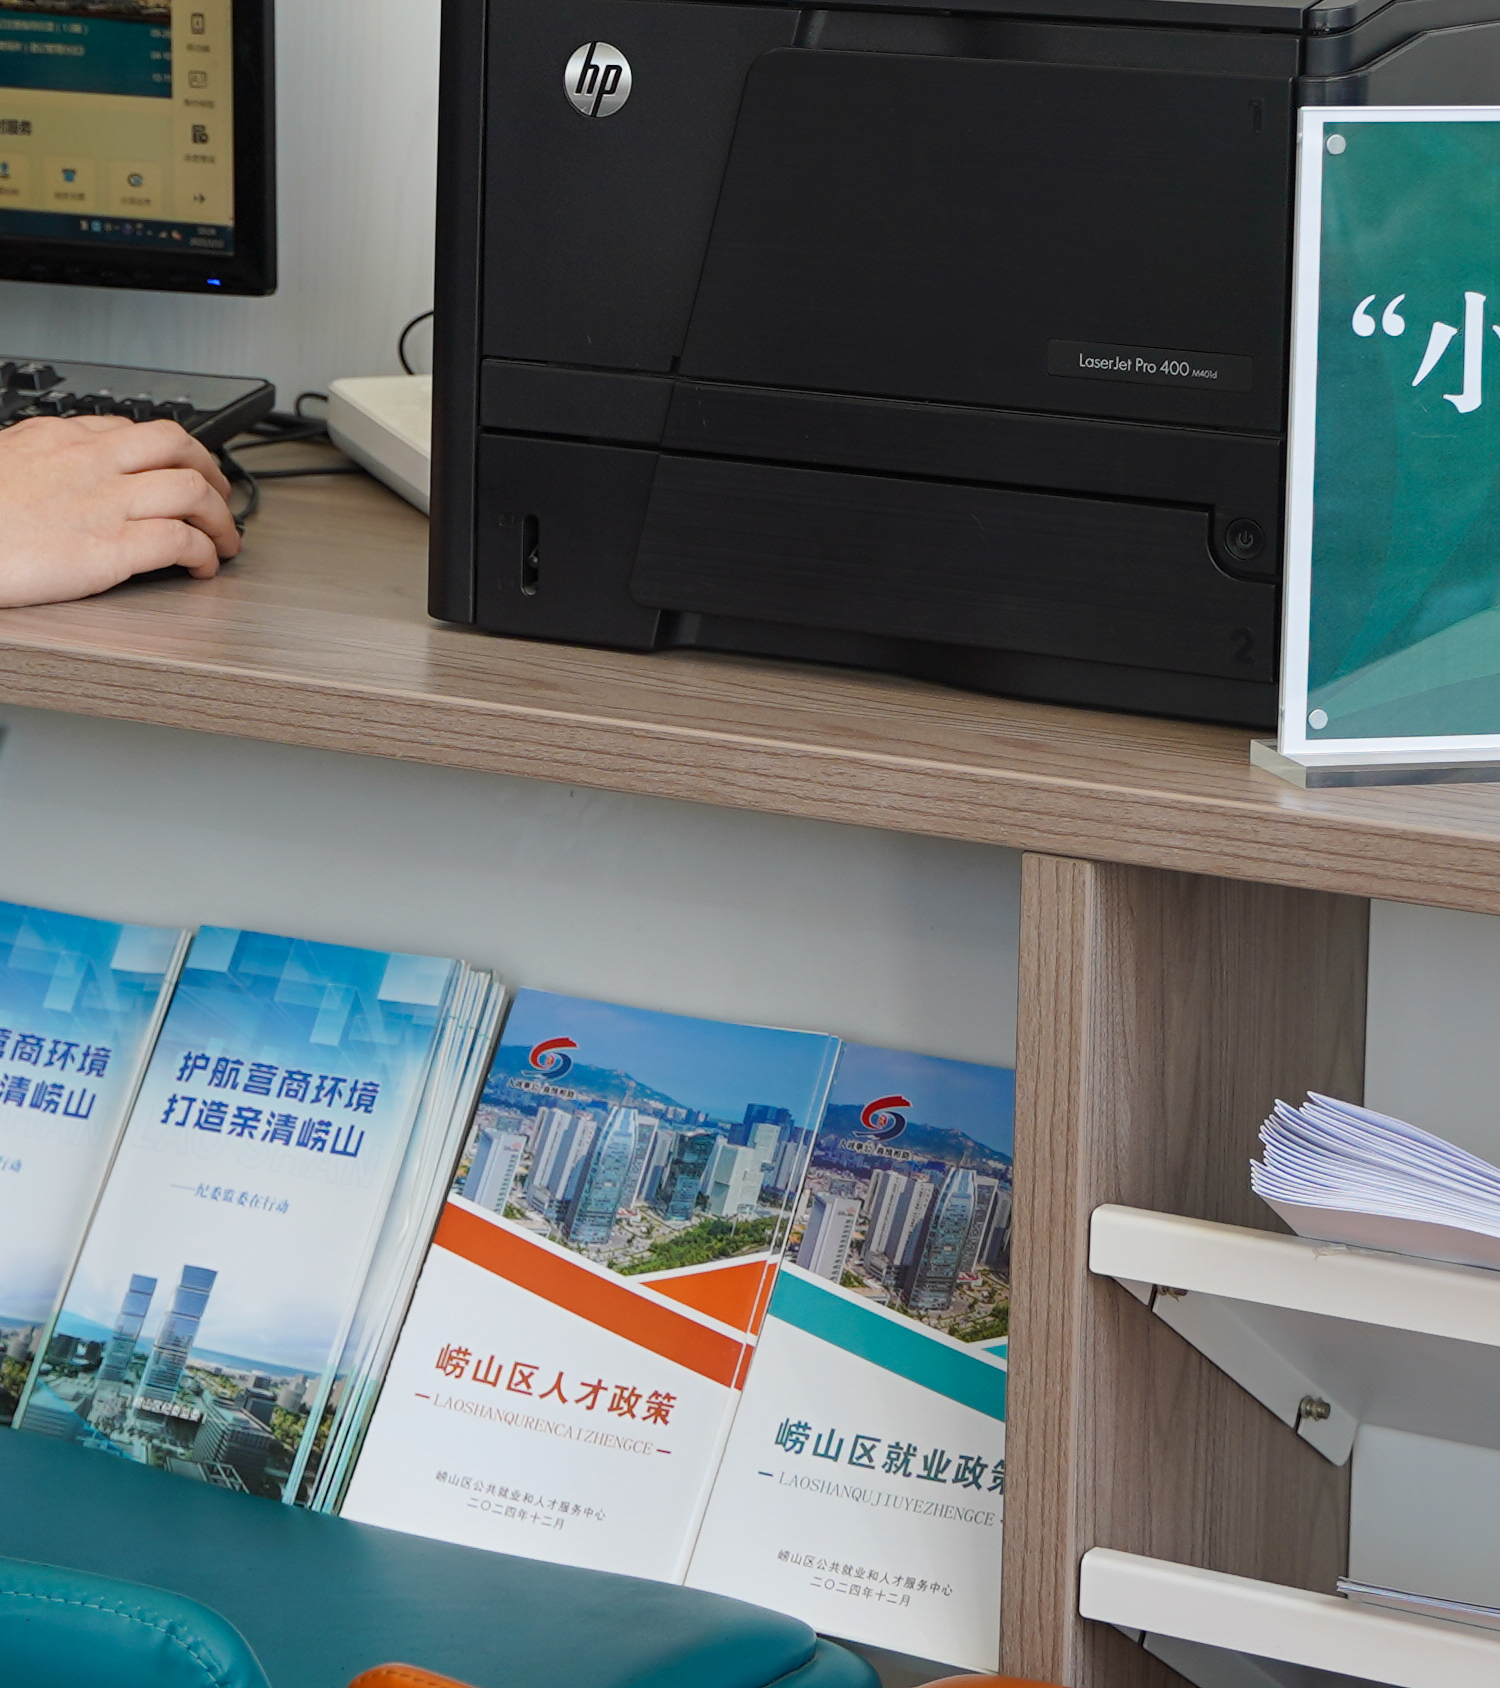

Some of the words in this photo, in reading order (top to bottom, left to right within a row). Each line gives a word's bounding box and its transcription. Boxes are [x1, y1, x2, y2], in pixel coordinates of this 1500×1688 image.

[574, 41, 623, 118] hp
[1079, 352, 1132, 373] LaserJet
[1135, 357, 1157, 374] Pro
[1160, 360, 1190, 377] 400
[174, 1050, 381, 1115] 护航营商环境
[160, 1093, 366, 1159] 打造亲清崂山
[434, 1342, 678, 1427] 崂山区人才政策
[434, 1469, 607, 1522] 崂山区公共就业和人才服务中心
[776, 1548, 954, 1597] 崂山区公共就业和人才服务中心
